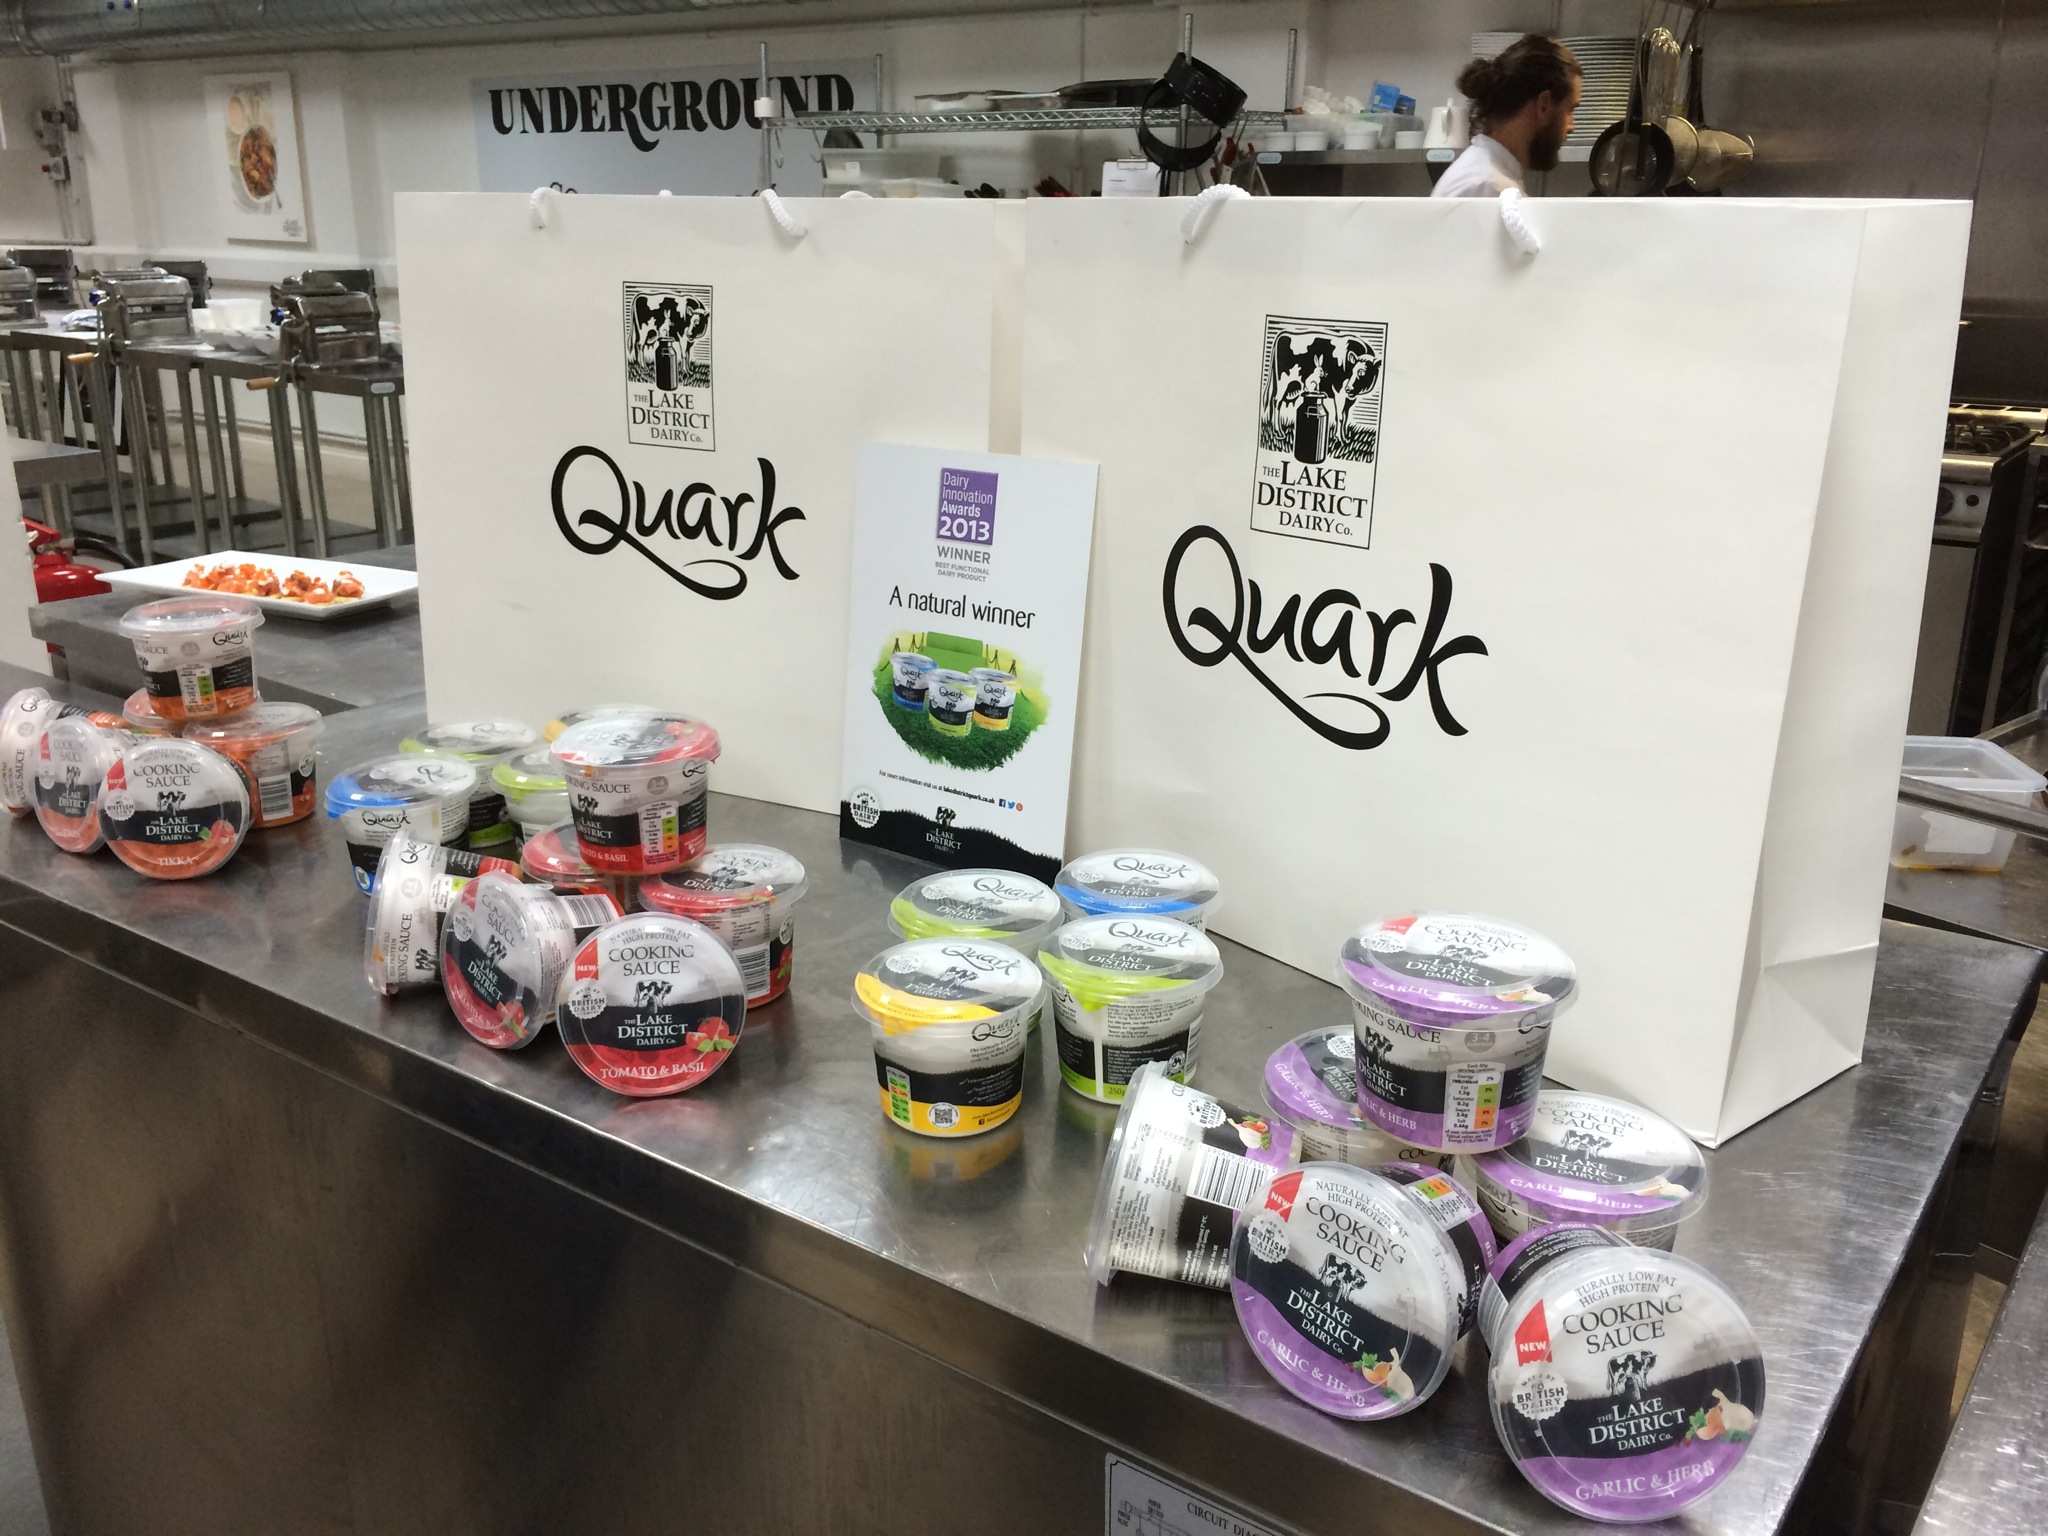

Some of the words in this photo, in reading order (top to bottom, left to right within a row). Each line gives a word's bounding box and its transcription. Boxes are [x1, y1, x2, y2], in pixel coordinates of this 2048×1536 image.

[488, 74, 854, 152] UNDERGROUND
[634, 394, 648, 403] THE
[648, 390, 694, 410] LAKE
[631, 406, 710, 430] DISTRICT
[651, 427, 690, 442] DAIRY
[690, 433, 704, 443] Co.
[944, 472, 970, 490] Dairy
[1262, 466, 1280, 478] THE
[1280, 460, 1346, 491] LAKE
[942, 486, 994, 504] Innovation
[1257, 481, 1368, 519] DISTRICT
[941, 501, 982, 518] Awards
[551, 445, 807, 601] Quark
[939, 516, 990, 542] 2013
[1279, 511, 1335, 534] DAIRY
[1335, 522, 1354, 536] Co.
[936, 544, 991, 564] WINNER
[938, 570, 956, 578] DAIRY
[957, 572, 986, 582] PRODUCT
[950, 564, 990, 576] FUNCTIONAL
[889, 586, 902, 607] A
[908, 592, 966, 618] natural
[972, 600, 1036, 629] winner
[1163, 525, 1489, 750] Quark
[939, 686, 964, 702] Quark
[984, 684, 1008, 698] Quark
[15, 748, 26, 780] SAUCE
[134, 764, 200, 776] COOKING
[146, 776, 191, 788] SAUCE
[592, 784, 631, 794] SAUCE
[58, 797, 86, 808] DISTRICT
[852, 802, 879, 816] BRITISH
[160, 816, 188, 826] LAKE
[362, 810, 411, 830] Quark
[581, 817, 602, 830] LAKE
[854, 810, 876, 821] DAIRY
[146, 824, 200, 836] DISTRICT
[576, 822, 613, 839] DISTRICT
[936, 828, 954, 840] LAKE
[926, 832, 962, 850] DISTRICT
[158, 856, 194, 866] TIKKA
[604, 854, 628, 862] BASIL
[1113, 856, 1193, 879] Quark
[973, 876, 1046, 902] Quark
[1101, 888, 1162, 898] DISTRICT
[956, 904, 988, 914] LAKE
[400, 913, 412, 952] SAUCE
[622, 934, 644, 946] HIGH
[645, 933, 679, 942] PROTEIN
[678, 929, 692, 940] FAT
[1108, 921, 1195, 948] Quark
[1424, 925, 1528, 952] COOKING
[608, 945, 694, 962] COOKING
[1435, 936, 1506, 954] SAUCE
[940, 945, 1021, 976] Quark
[1088, 955, 1155, 970] DISTRICT
[1109, 952, 1144, 964] LAKE
[1432, 958, 1478, 974] LAKE
[480, 960, 498, 985] LAKE
[577, 964, 596, 972] NEW
[623, 960, 680, 976] SAUCE
[1406, 961, 1496, 987] DISTRICT
[1425, 971, 1461, 983] DAIRY
[468, 961, 504, 1000] DISTRICT
[473, 980, 489, 998] DAIRY
[572, 998, 605, 1006] BRITISH
[636, 1014, 673, 1026] LAKE
[617, 1024, 688, 1039] DISTRICT
[1387, 1017, 1441, 1044] SAUCE
[1472, 1033, 1490, 1042] 3-4
[636, 1037, 665, 1046] DAIRY
[600, 1066, 658, 1080] TOMATO
[658, 1064, 670, 1074] &
[672, 1061, 708, 1074] BASIL
[1366, 1056, 1393, 1081] LAKE
[1324, 1074, 1342, 1092] DAIRY
[1358, 1058, 1408, 1098] DISTRICT
[1366, 1080, 1386, 1098] DAIRY
[1200, 1101, 1212, 1124] BRITISH
[1208, 1104, 1218, 1125] DAIRY
[1378, 1109, 1386, 1118] &
[1388, 1114, 1417, 1130] HERB
[1537, 1106, 1645, 1132] COOKING
[1552, 1117, 1624, 1138] SAUCE
[1535, 1156, 1628, 1183] DISTRICT
[1560, 1153, 1608, 1171] LAKE
[1134, 1166, 1142, 1182] Energy
[1155, 1160, 1166, 1188] Carbohydrate
[1557, 1169, 1596, 1182] DAIRY
[1270, 1191, 1292, 1209] NEW
[1328, 1192, 1354, 1206] HIGH
[1316, 1181, 1371, 1205] NATURALLY
[1394, 1220, 1410, 1239] FAT
[1306, 1196, 1406, 1264] COOKING
[1251, 1226, 1287, 1255] BRITISH
[1251, 1236, 1282, 1258] DAIRY
[1316, 1222, 1385, 1273] SAUCE
[1628, 1271, 1654, 1282] LOW
[1656, 1274, 1678, 1288] FAT
[1579, 1288, 1610, 1308] HIGH
[1612, 1283, 1660, 1296] PROTEIN
[1300, 1286, 1313, 1300] THE
[1310, 1288, 1353, 1328] LAKE
[1562, 1294, 1683, 1335] COOKING
[1286, 1288, 1365, 1352] DISTRICT
[1301, 1318, 1334, 1346] DAIRY
[1332, 1342, 1344, 1355] Co.
[1586, 1319, 1666, 1355] SAUCE
[1519, 1340, 1548, 1352] NEW
[1257, 1330, 1310, 1372] GARLIC
[1311, 1366, 1324, 1382] &
[1326, 1374, 1366, 1408] HERB
[1548, 1373, 1557, 1382] BY
[1522, 1397, 1562, 1412] DAIRY
[1597, 1414, 1614, 1424] THE
[1612, 1397, 1664, 1422] LAKE
[1588, 1408, 1686, 1445] DISTRICT
[1618, 1432, 1658, 1451] DAIRY
[1658, 1433, 1674, 1442] Co.
[1575, 1476, 1646, 1500] GARLIC
[1650, 1474, 1664, 1489] &
[1667, 1460, 1715, 1484] HERB
[1186, 1502, 1229, 1530] CIRCUIT
